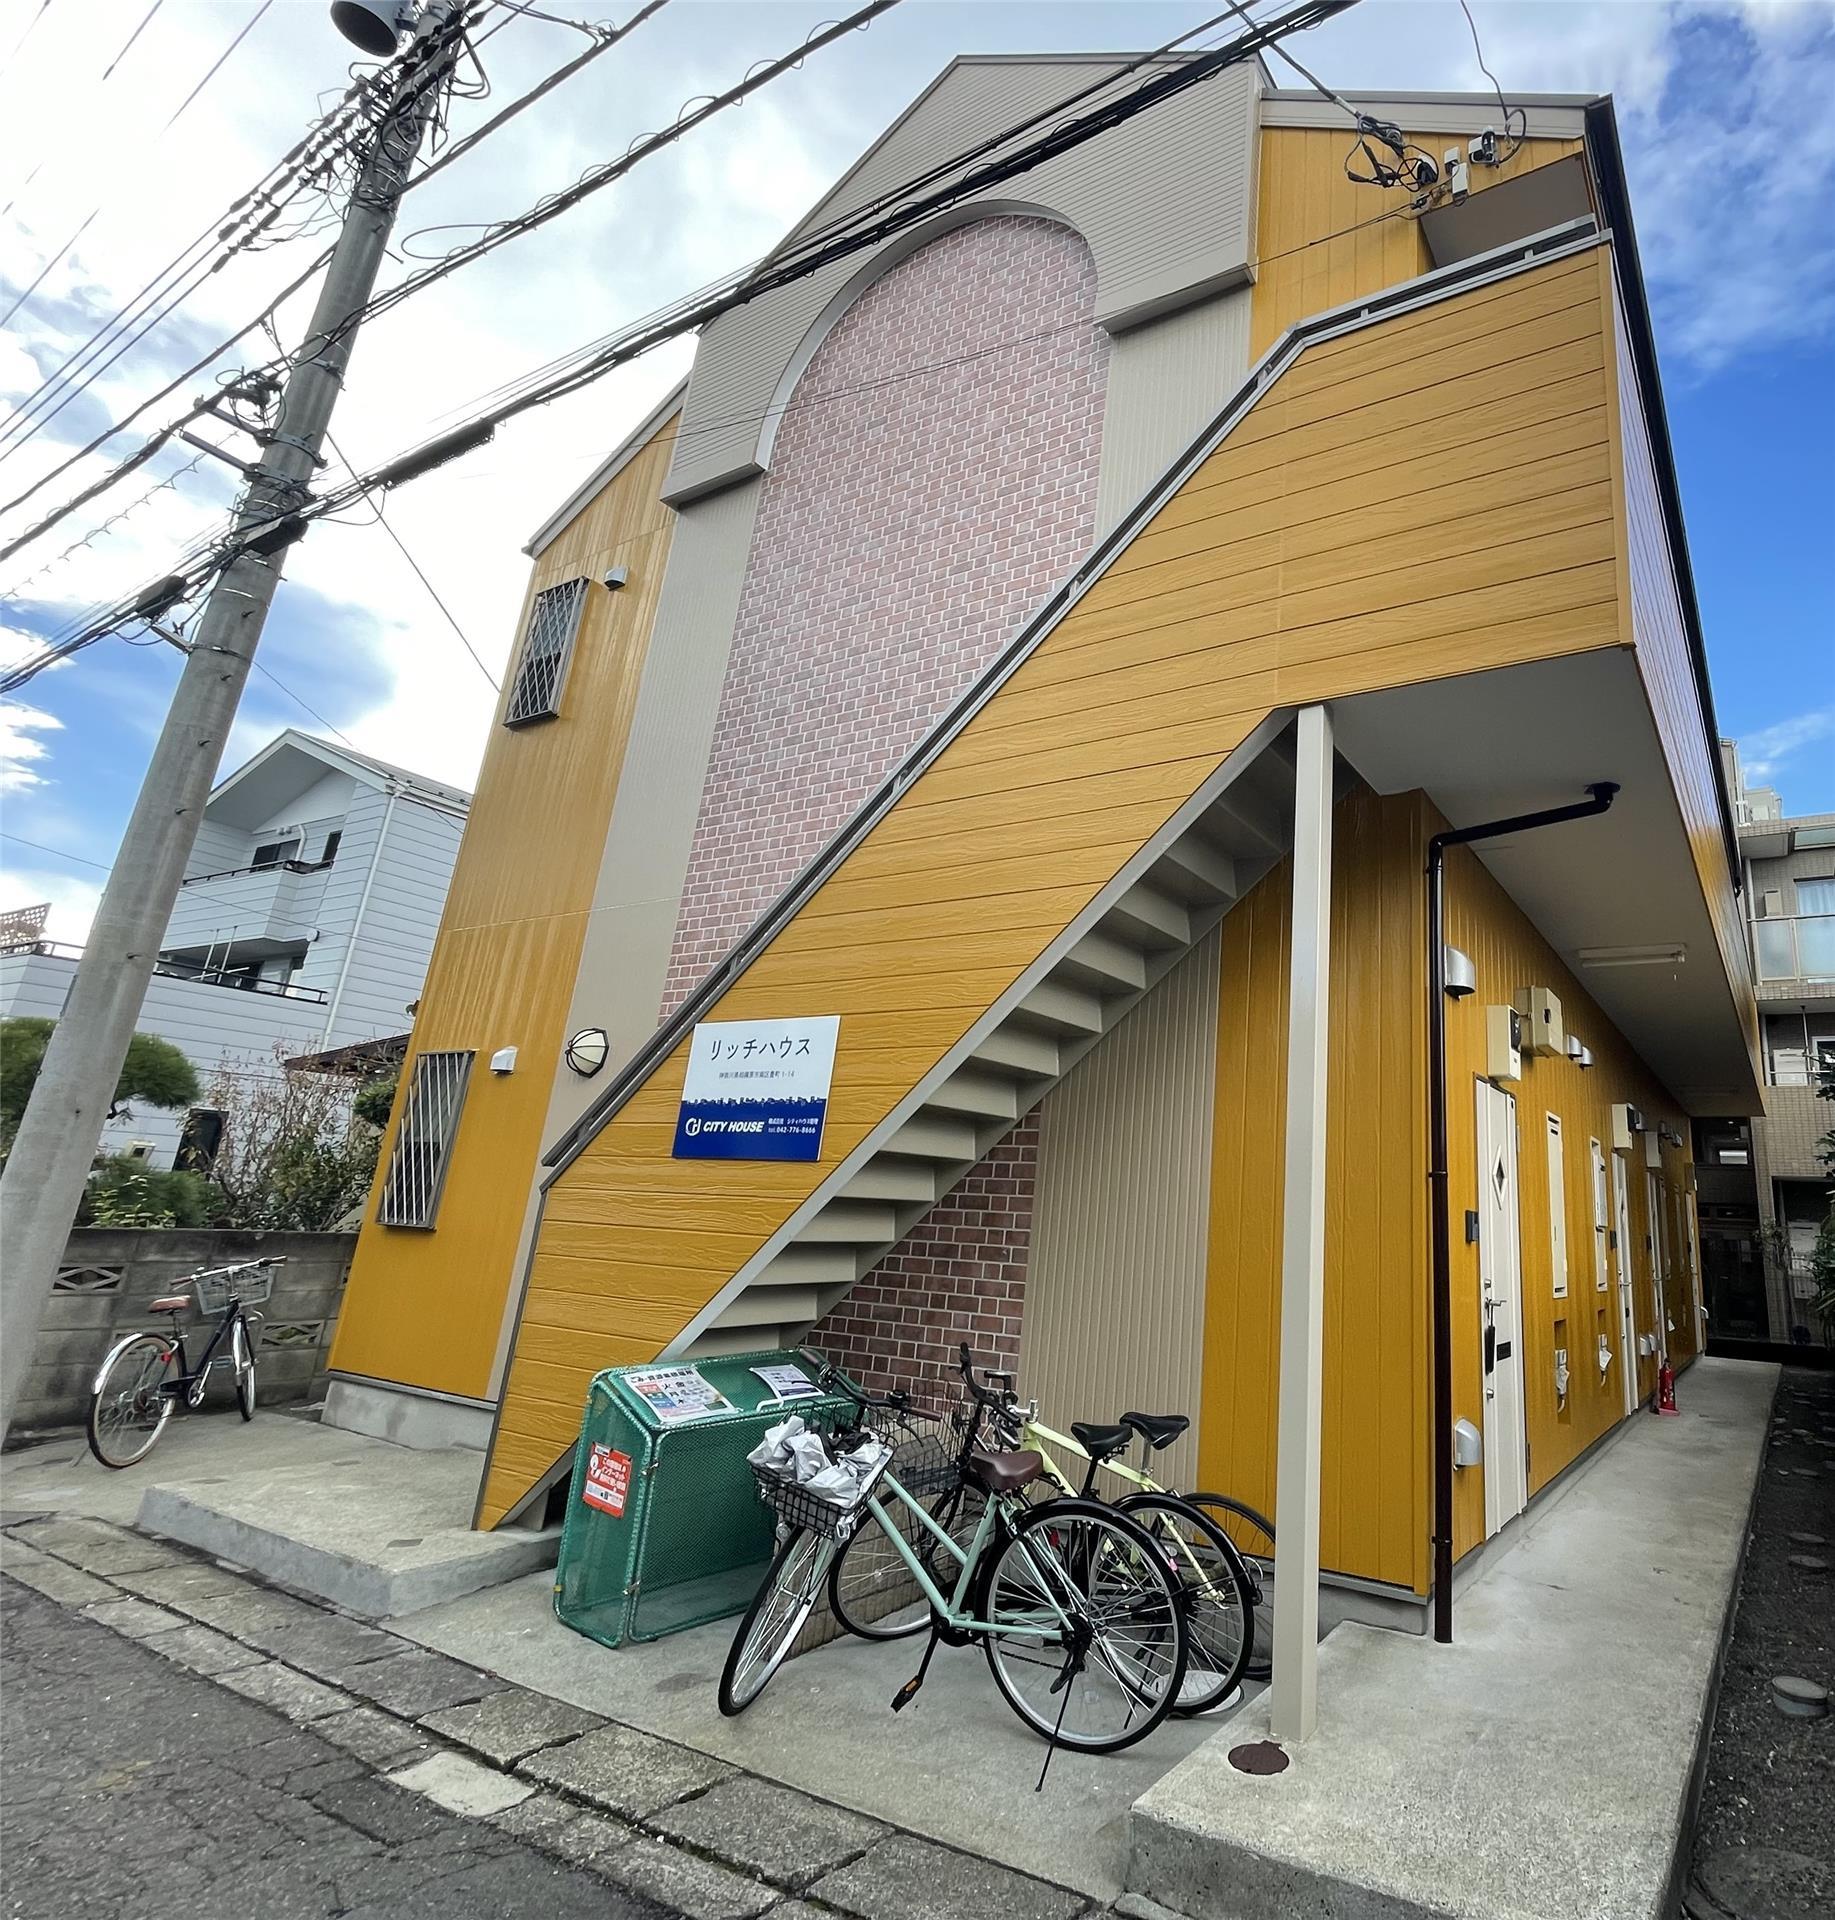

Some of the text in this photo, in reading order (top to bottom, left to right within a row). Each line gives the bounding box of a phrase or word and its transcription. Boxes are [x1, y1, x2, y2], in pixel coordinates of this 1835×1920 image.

[711, 1035, 812, 1061] リッチハウス
[703, 1121, 765, 1132] CITY HOUSE
